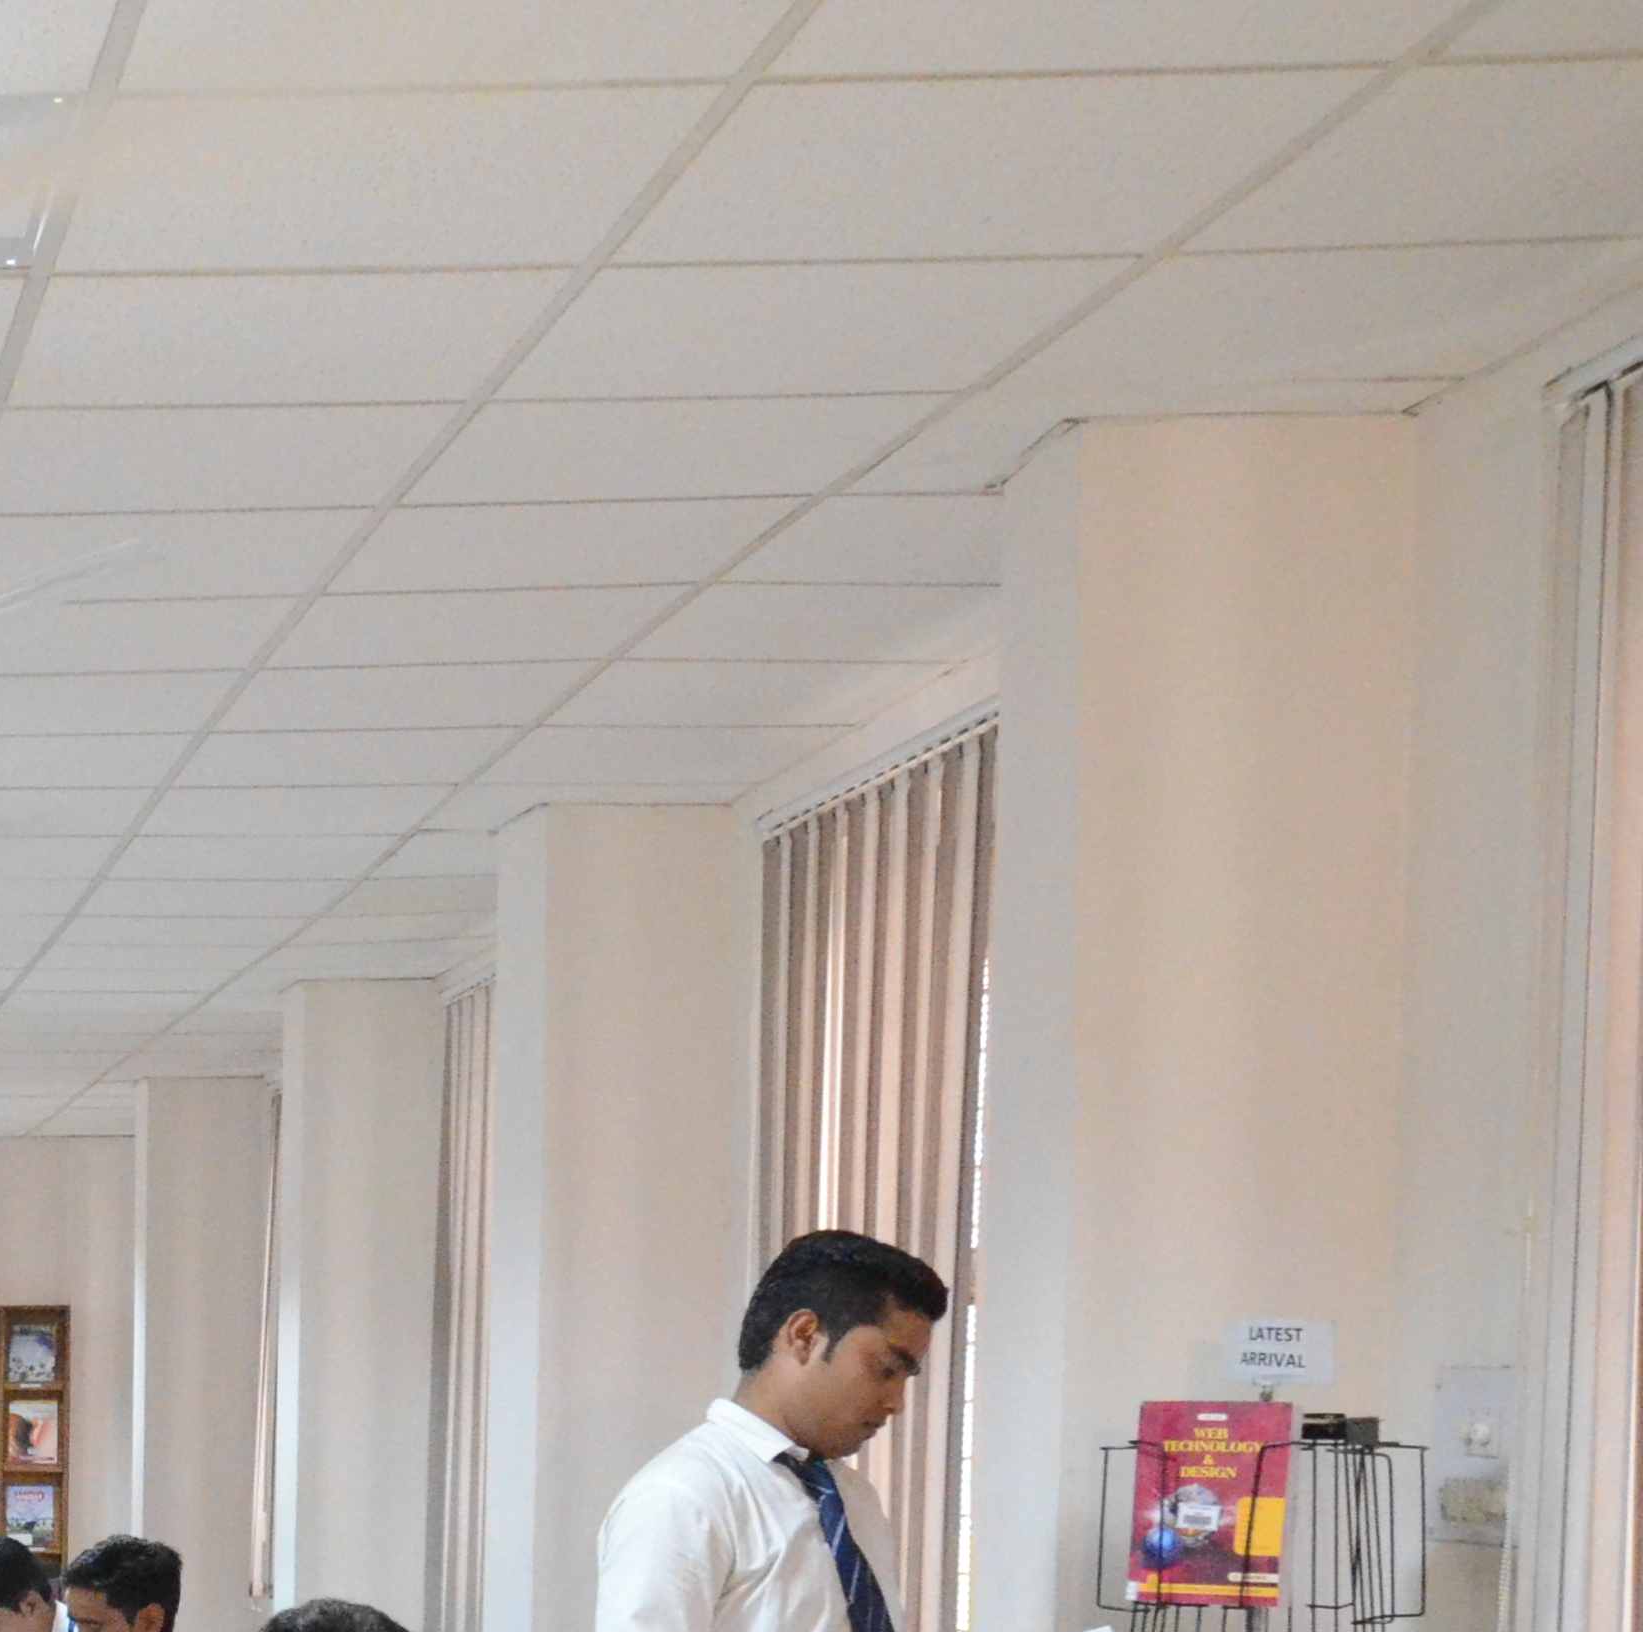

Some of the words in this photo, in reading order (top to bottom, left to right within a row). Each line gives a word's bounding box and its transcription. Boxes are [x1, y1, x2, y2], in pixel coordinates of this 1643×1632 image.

[1248, 1326, 1303, 1342] LATEST
[1240, 1351, 1305, 1369] ARRIVAL
[1194, 1427, 1229, 1440] WEB
[1163, 1440, 1263, 1453] TECHNOLOGY
[1203, 1454, 1215, 1465] &
[1180, 1465, 1238, 1479] DESIGN
